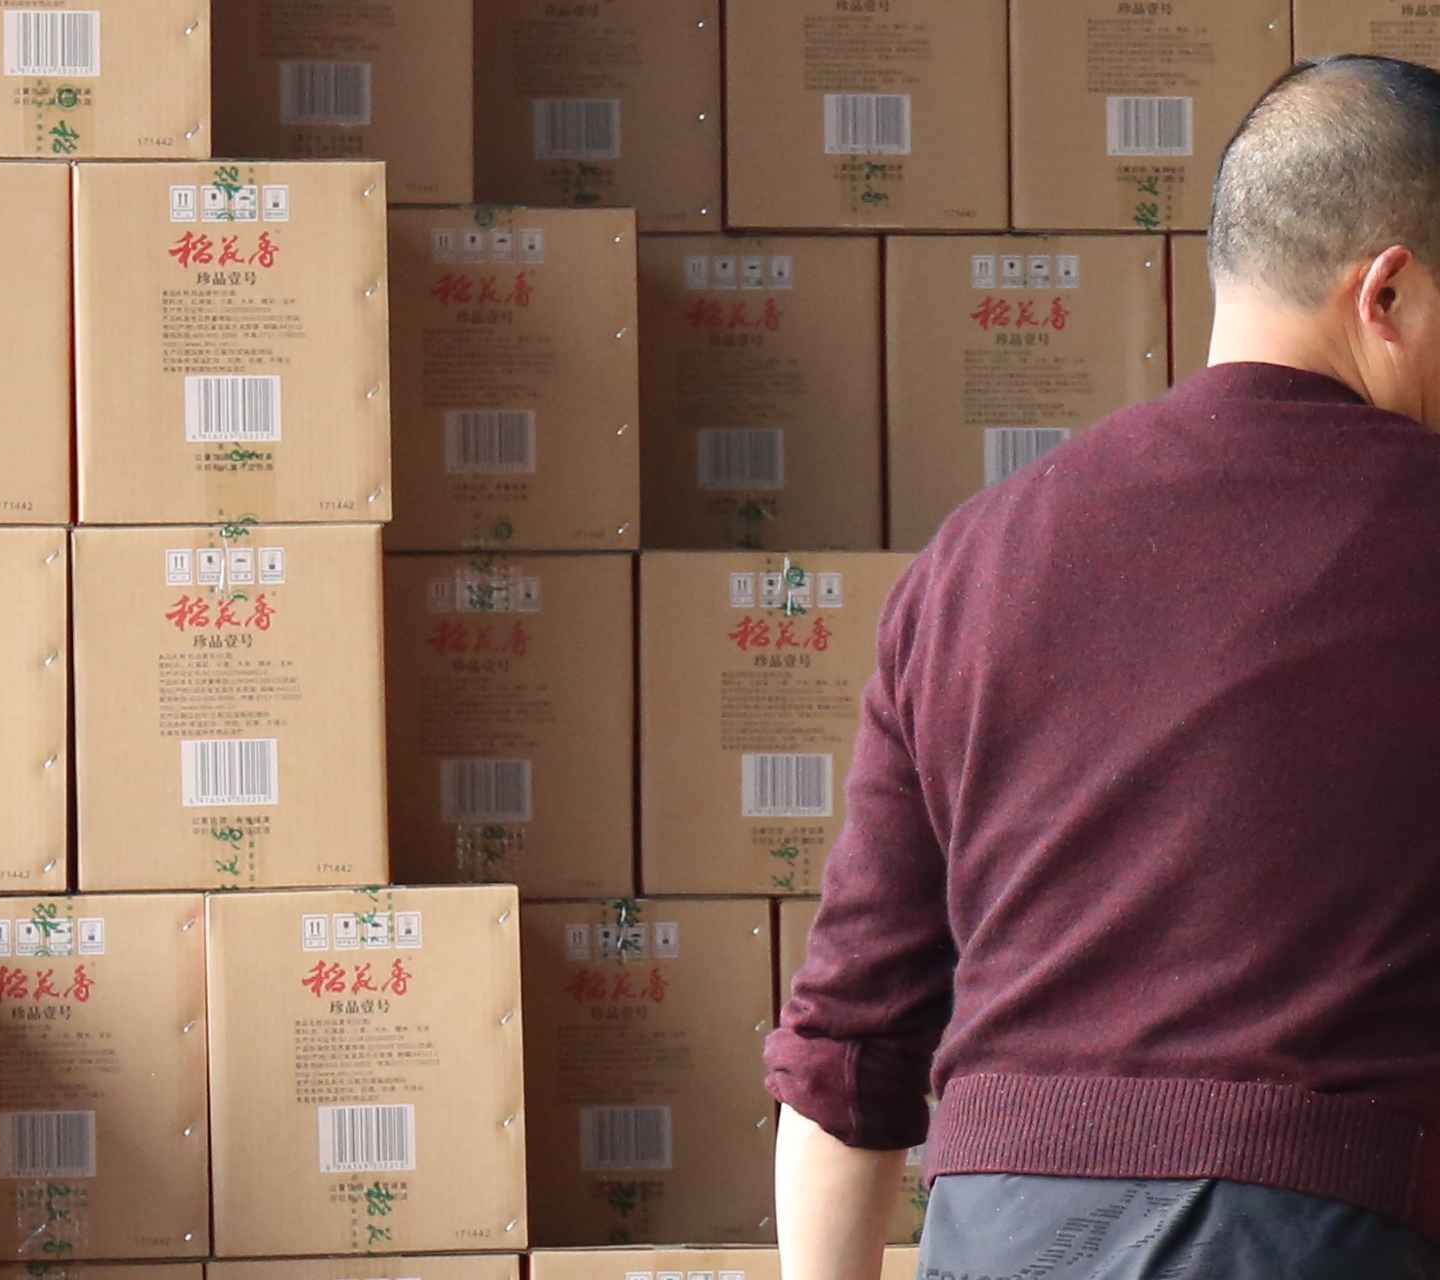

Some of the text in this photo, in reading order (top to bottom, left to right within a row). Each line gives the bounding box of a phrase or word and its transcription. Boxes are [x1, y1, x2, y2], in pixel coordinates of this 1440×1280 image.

[168, 230, 280, 269] 稻花香
[165, 594, 275, 632] 稻花香
[192, 632, 253, 650] 珍品壹号
[302, 958, 411, 997] 稻花香
